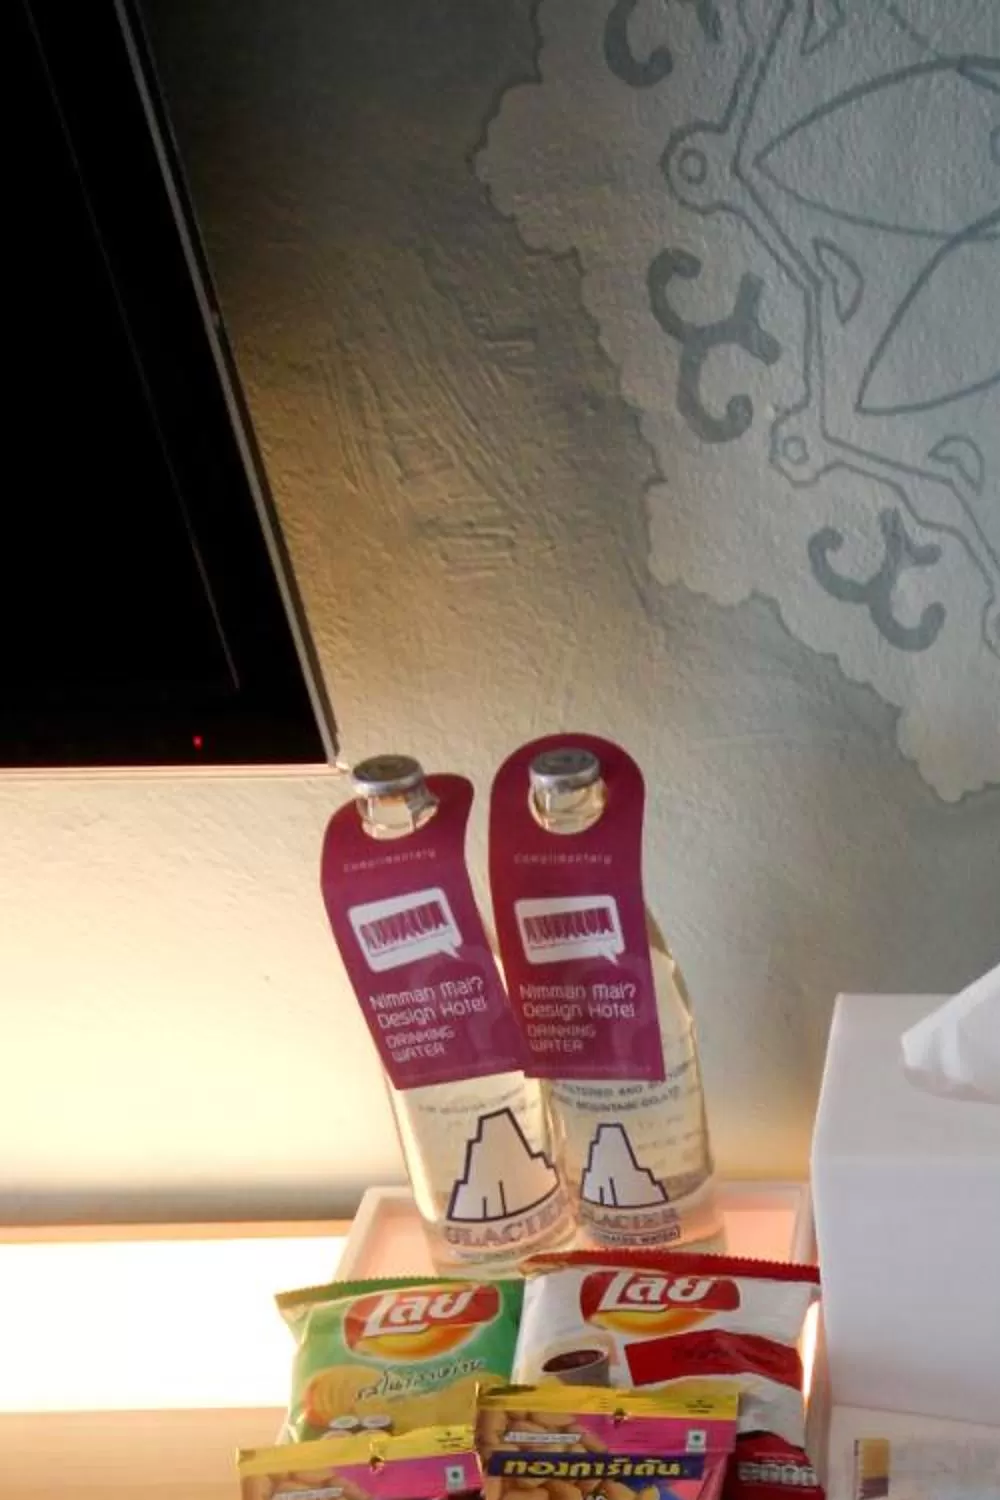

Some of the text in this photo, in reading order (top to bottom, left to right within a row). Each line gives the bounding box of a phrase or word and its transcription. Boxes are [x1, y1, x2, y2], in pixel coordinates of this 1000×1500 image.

[369, 986, 437, 1011] Nimman
[519, 983, 586, 1000] Nimman
[377, 997, 488, 1030] Design Hotel
[523, 1002, 636, 1021] Design Hotel
[385, 1025, 456, 1049] DRINKING
[527, 1023, 597, 1039] DRINKING
[391, 1043, 446, 1064] WATER
[530, 1038, 585, 1053] WATER
